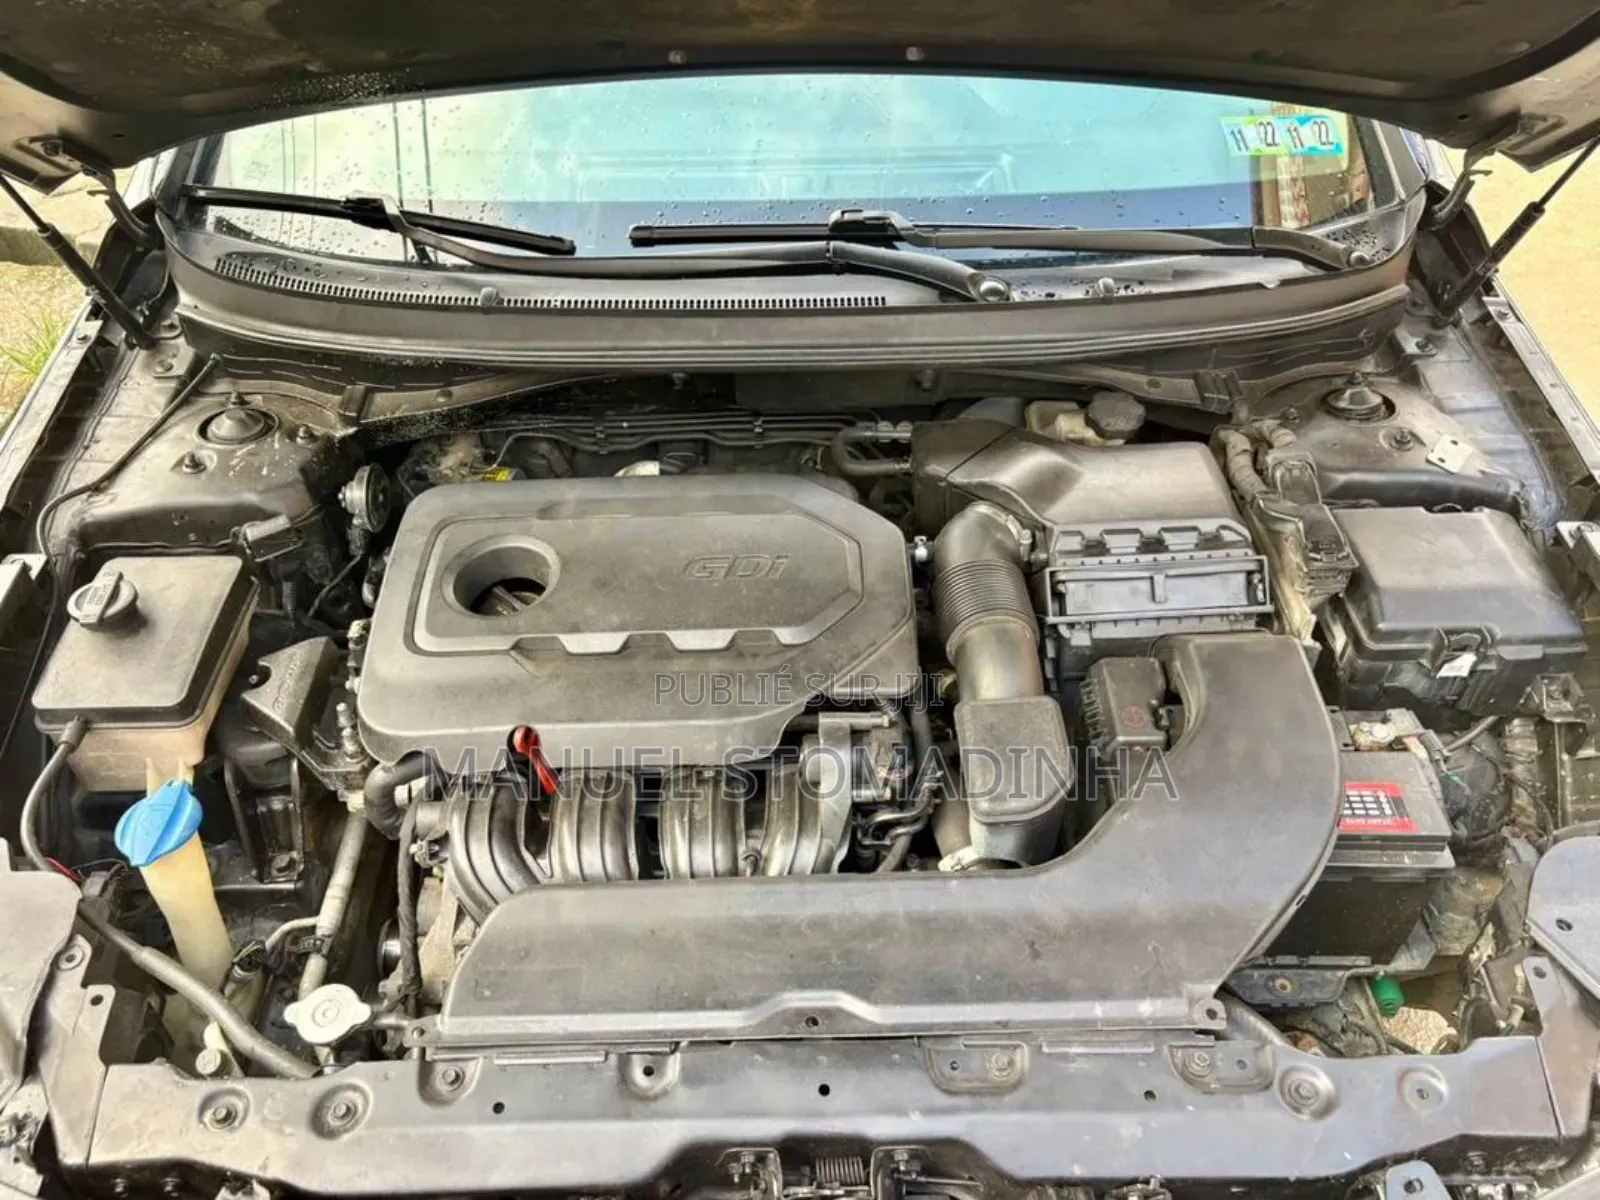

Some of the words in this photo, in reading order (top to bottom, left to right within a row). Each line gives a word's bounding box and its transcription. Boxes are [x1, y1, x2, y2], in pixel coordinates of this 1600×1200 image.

[1230, 128, 1249, 152] 11
[1287, 125, 1305, 149] 11
[682, 553, 791, 579] GDi
